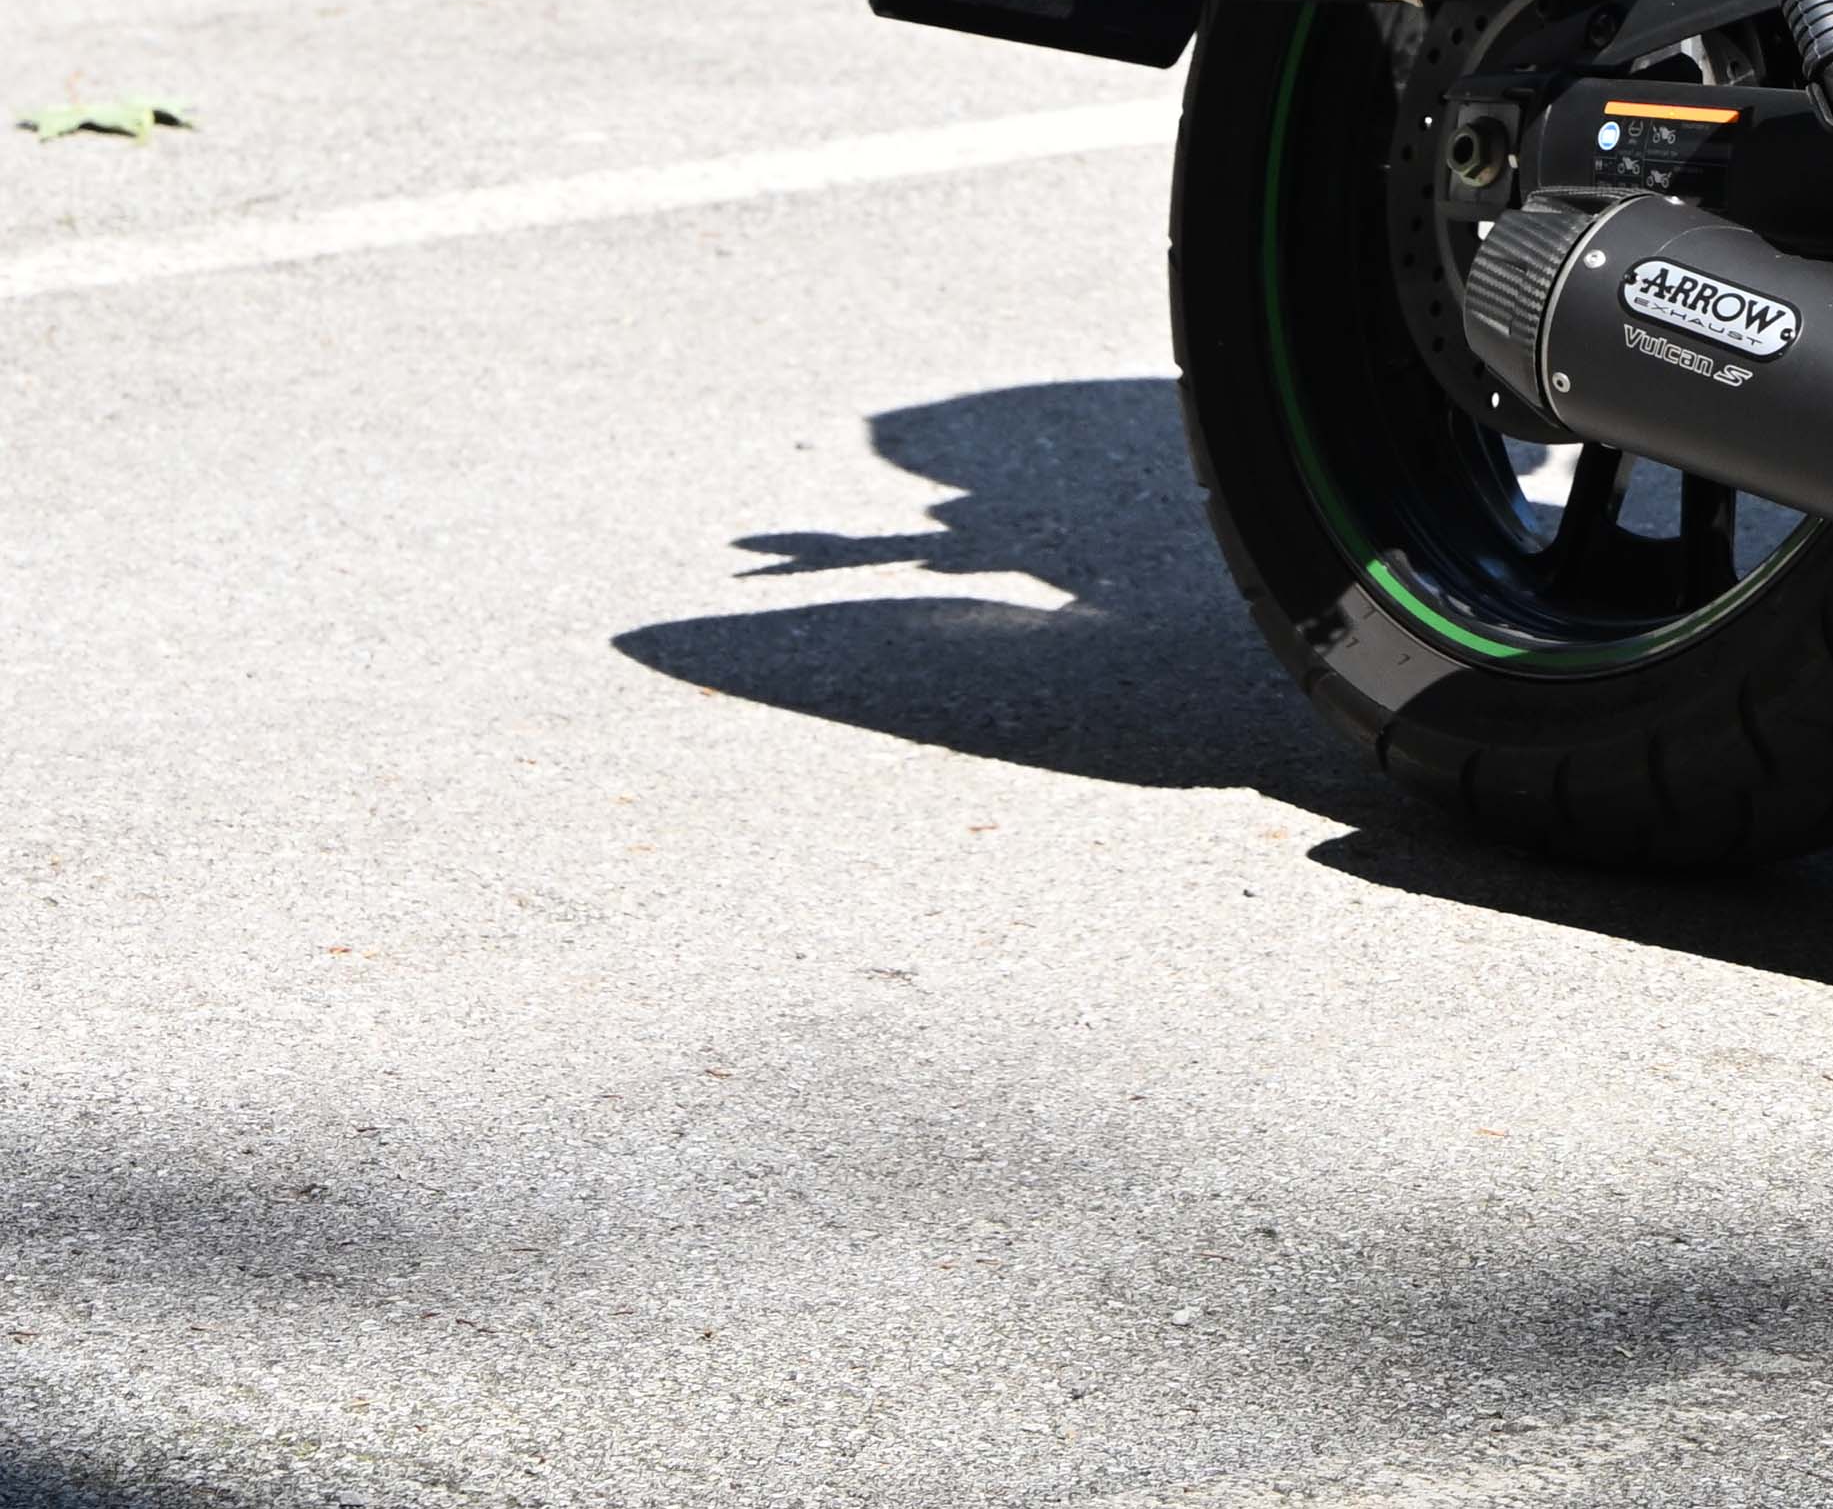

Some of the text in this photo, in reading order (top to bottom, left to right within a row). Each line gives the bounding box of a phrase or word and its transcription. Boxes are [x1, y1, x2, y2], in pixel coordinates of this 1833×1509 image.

[1634, 297, 1763, 347] EXHAUST
[1640, 268, 1786, 334] ARROW
[1624, 324, 1753, 387] Vulcan S
